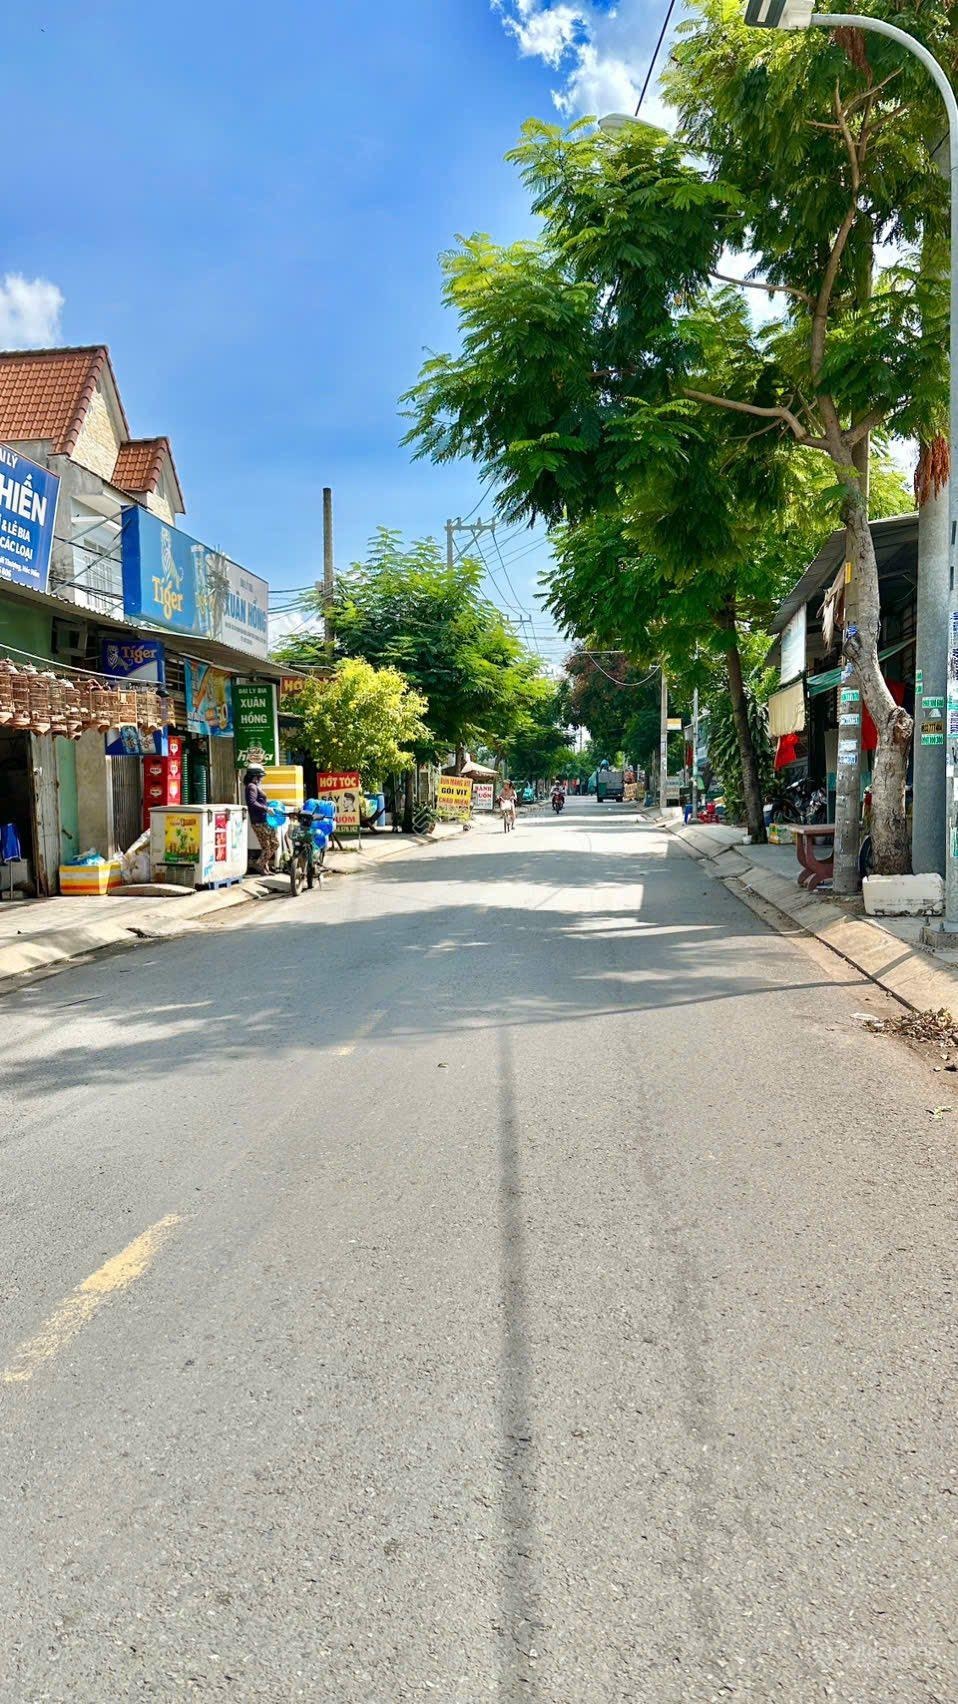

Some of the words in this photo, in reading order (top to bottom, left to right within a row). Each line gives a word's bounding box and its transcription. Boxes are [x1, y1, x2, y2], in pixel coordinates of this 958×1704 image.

[1, 519, 7, 532] &
[17, 527, 31, 543] BIA
[16, 543, 33, 562] LOẠI
[152, 575, 184, 620] Tiger
[121, 645, 158, 664] Tiger
[240, 696, 266, 708] XUÂN
[339, 774, 357, 787] TÓC
